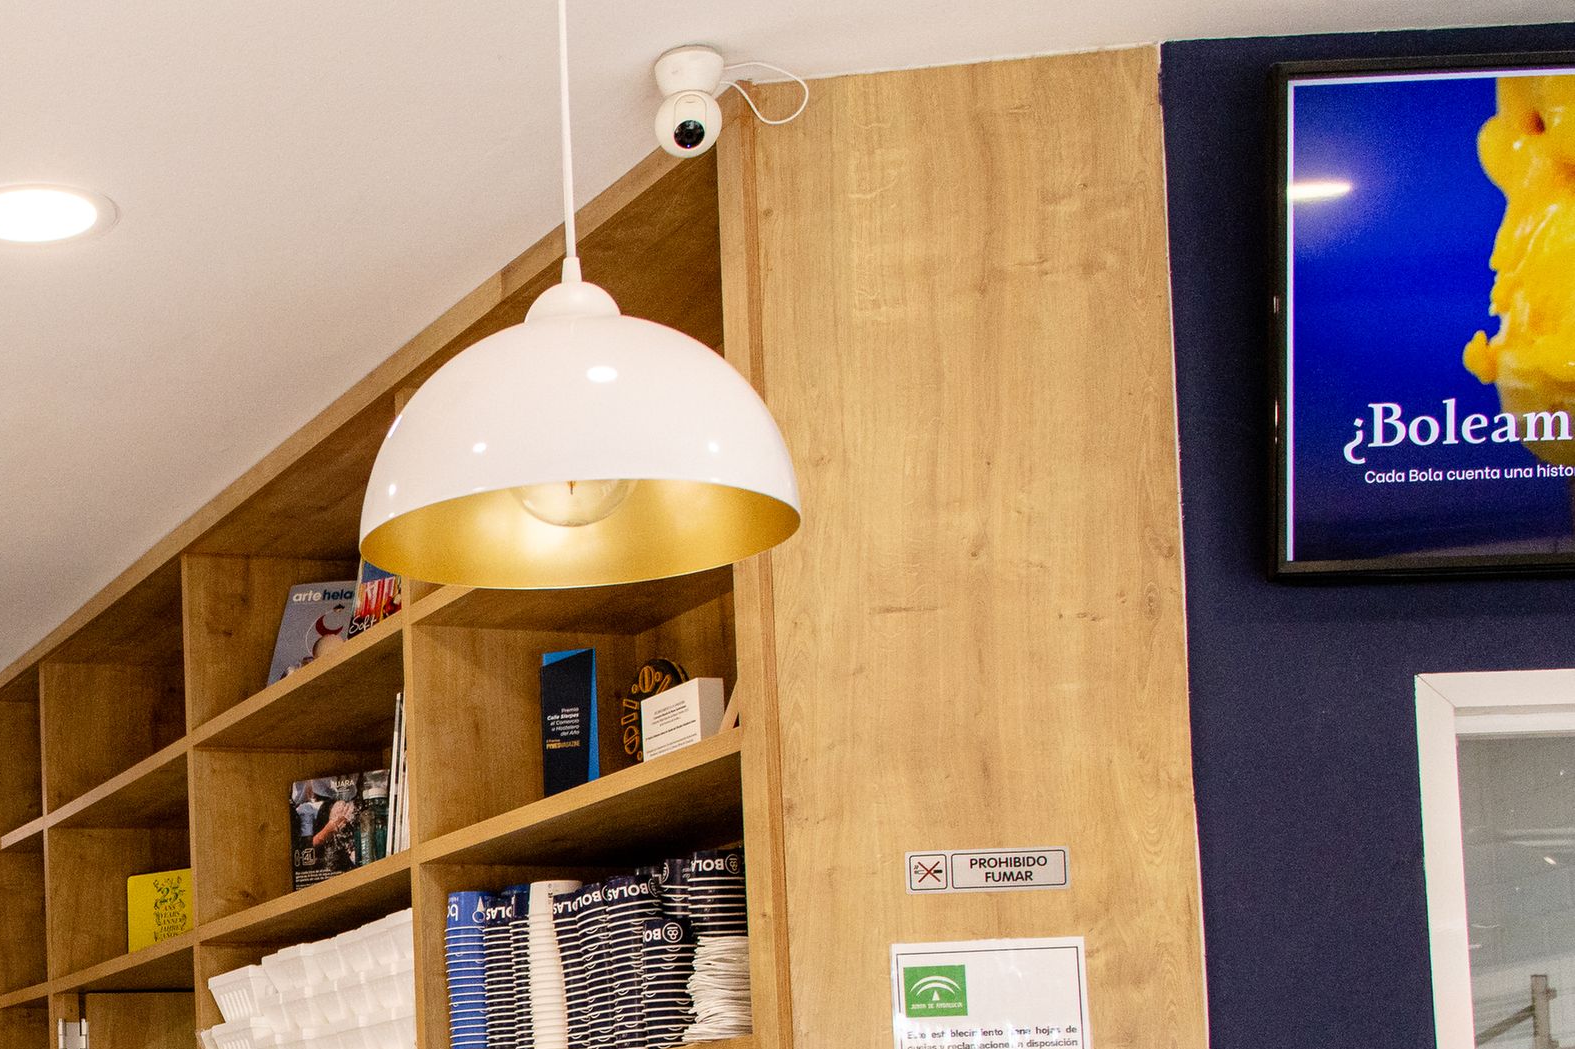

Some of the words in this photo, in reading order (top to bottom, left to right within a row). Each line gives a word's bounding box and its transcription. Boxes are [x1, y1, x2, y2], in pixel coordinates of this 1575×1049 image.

[1364, 469, 1405, 484] Cada
[1409, 468, 1443, 482] Bola
[1446, 466, 1500, 481] cuenta
[1504, 466, 1533, 479] una
[1537, 463, 1575, 478] histo
[969, 856, 1047, 869] PROHIBIDO
[985, 870, 1033, 883] FUMAR
[1066, 1026, 1078, 1034] de
[1026, 1039, 1078, 1049] disposición
